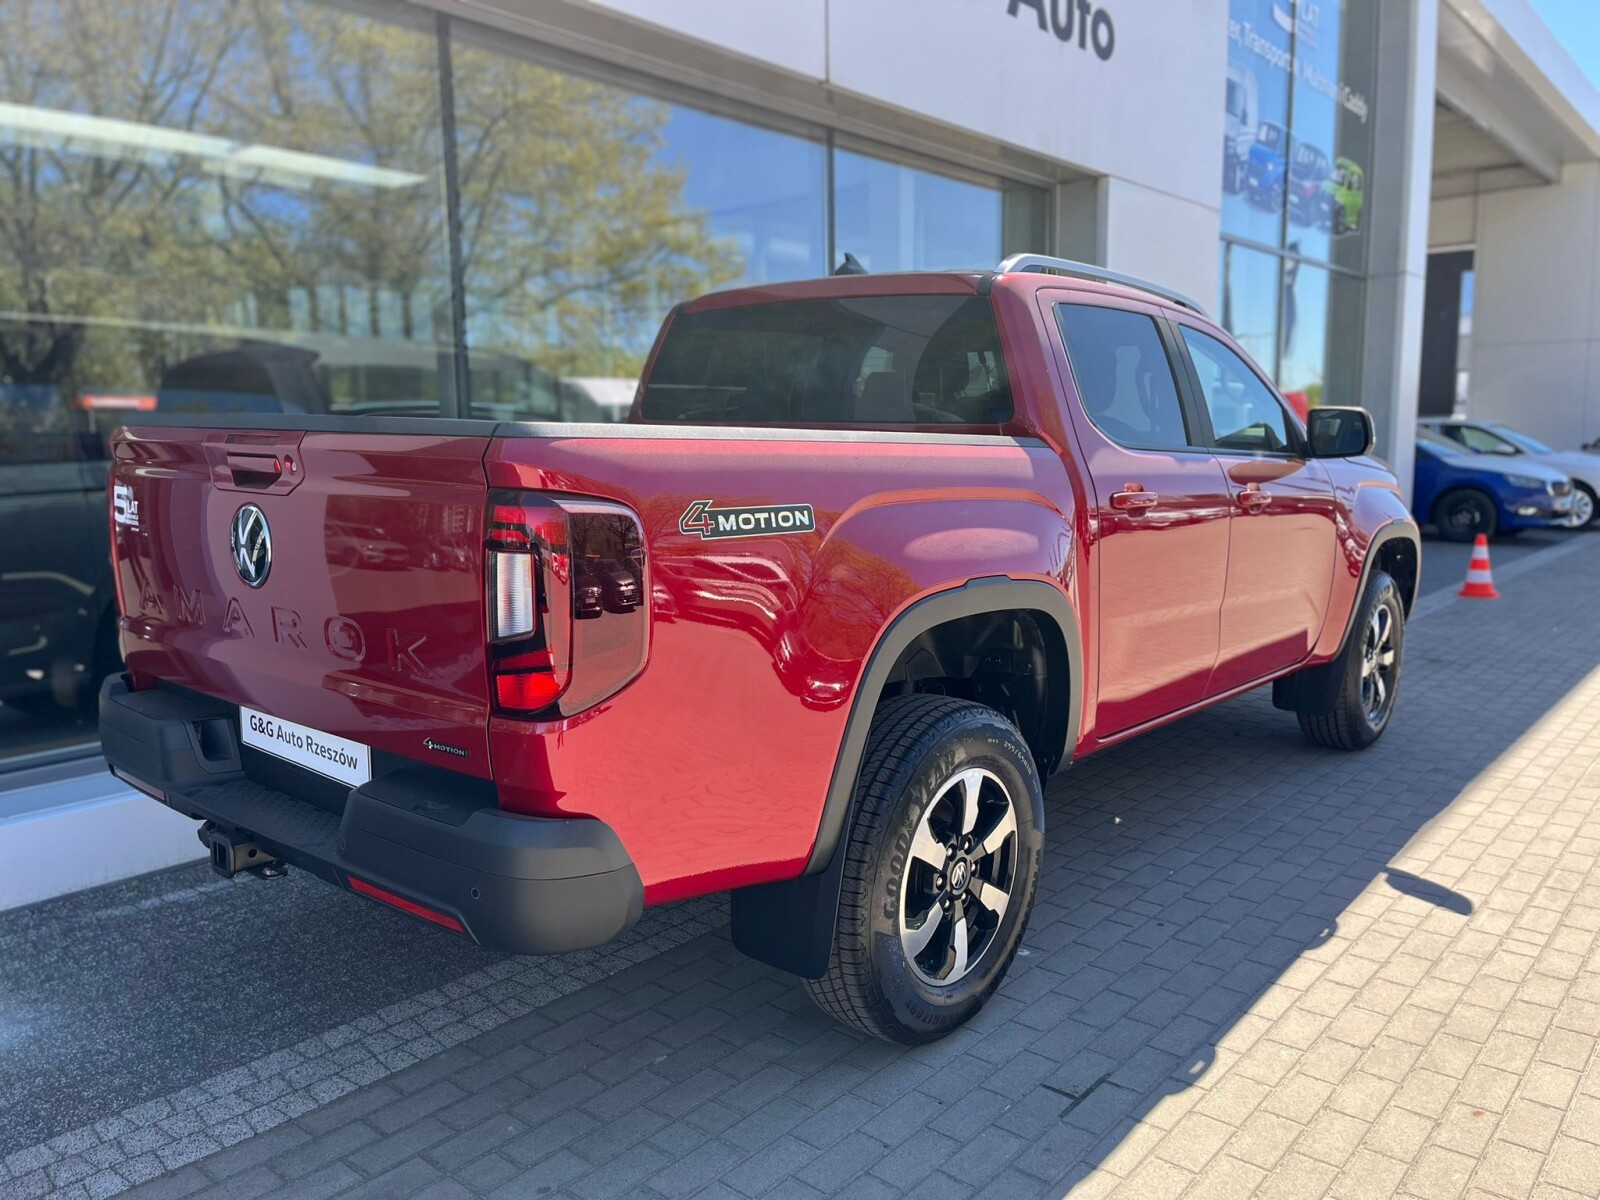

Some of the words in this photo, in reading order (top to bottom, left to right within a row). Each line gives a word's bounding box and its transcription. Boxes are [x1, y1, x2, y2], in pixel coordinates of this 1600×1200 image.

[682, 503, 810, 536] 4MOTION
[140, 577, 433, 679] AMAROK
[249, 714, 274, 738] G&G
[276, 724, 304, 749] Auto
[306, 735, 358, 770] Rzeszów
[423, 737, 465, 756] 4MOTION
[884, 746, 960, 920] GOODYEAR
